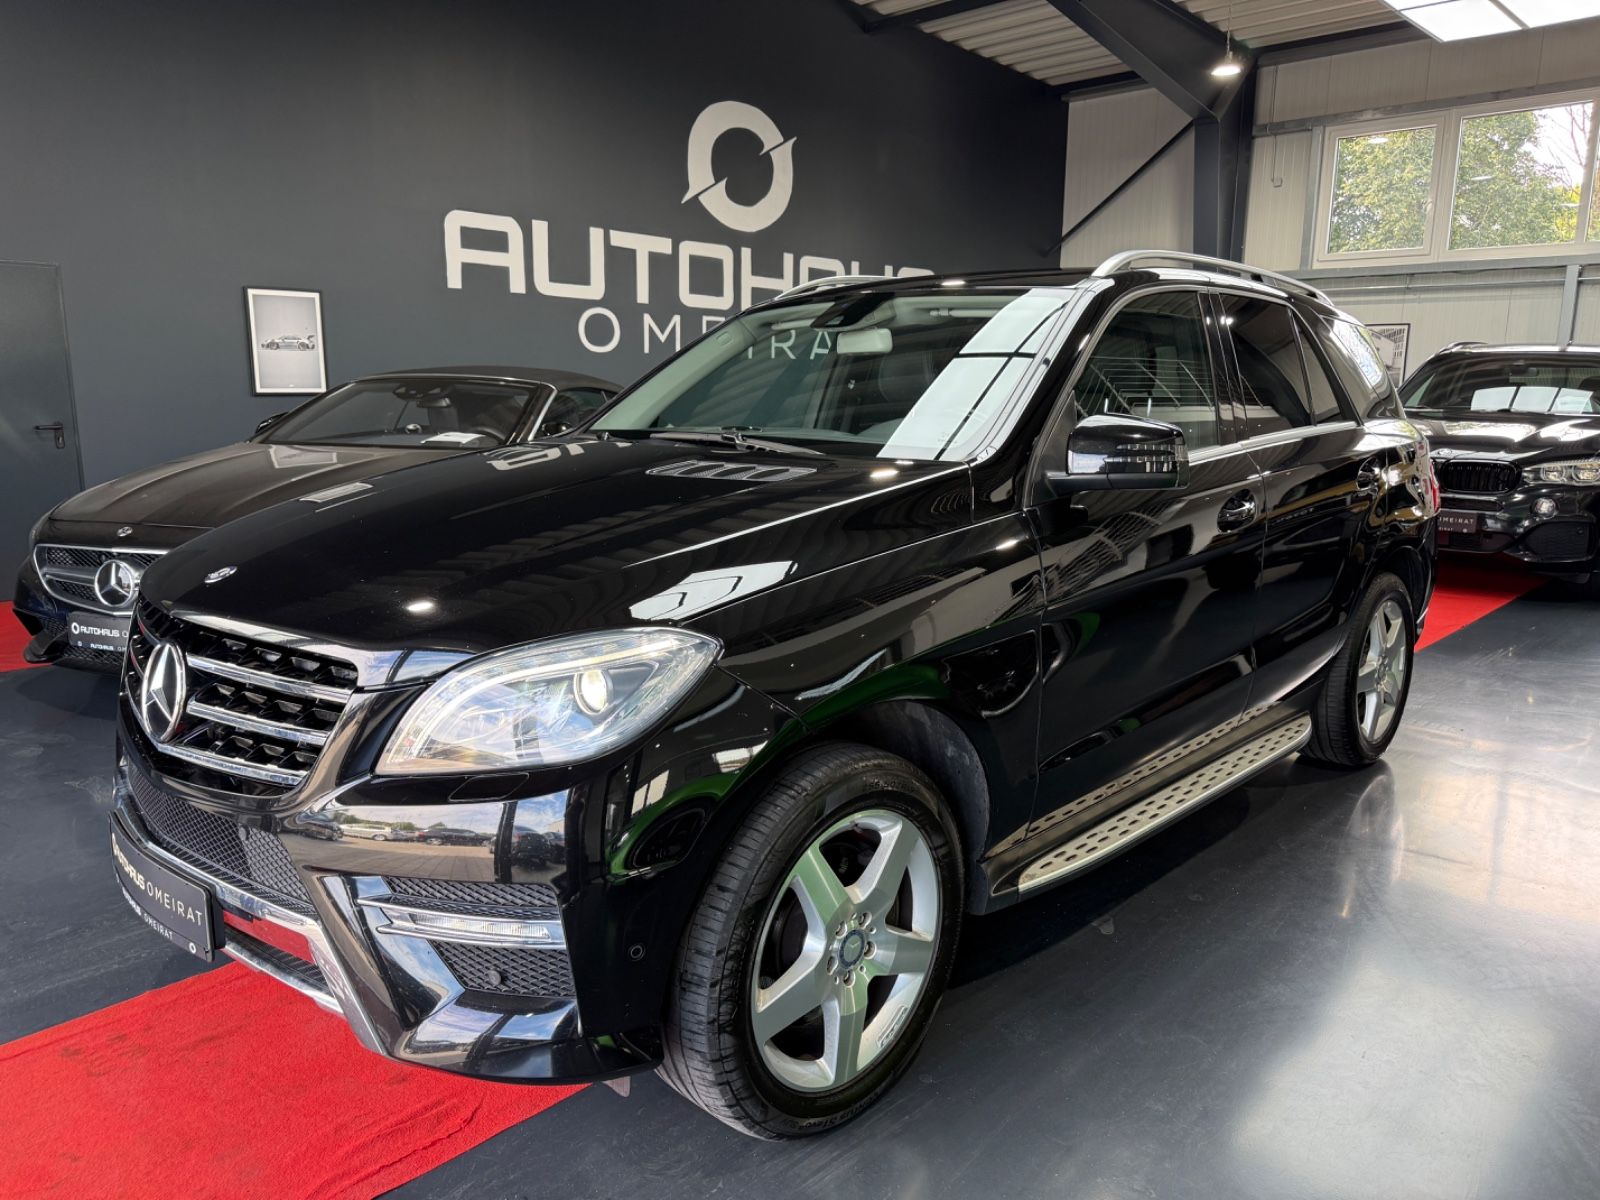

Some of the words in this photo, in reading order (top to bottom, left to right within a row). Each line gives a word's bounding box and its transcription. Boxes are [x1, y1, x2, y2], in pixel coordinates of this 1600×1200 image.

[443, 209, 935, 309] AUTOH
[577, 307, 832, 360] OMRA
[80, 626, 120, 637] AUTOHAUS
[146, 881, 203, 926] OMEIRAT
[143, 913, 174, 941] OMEIRAT
